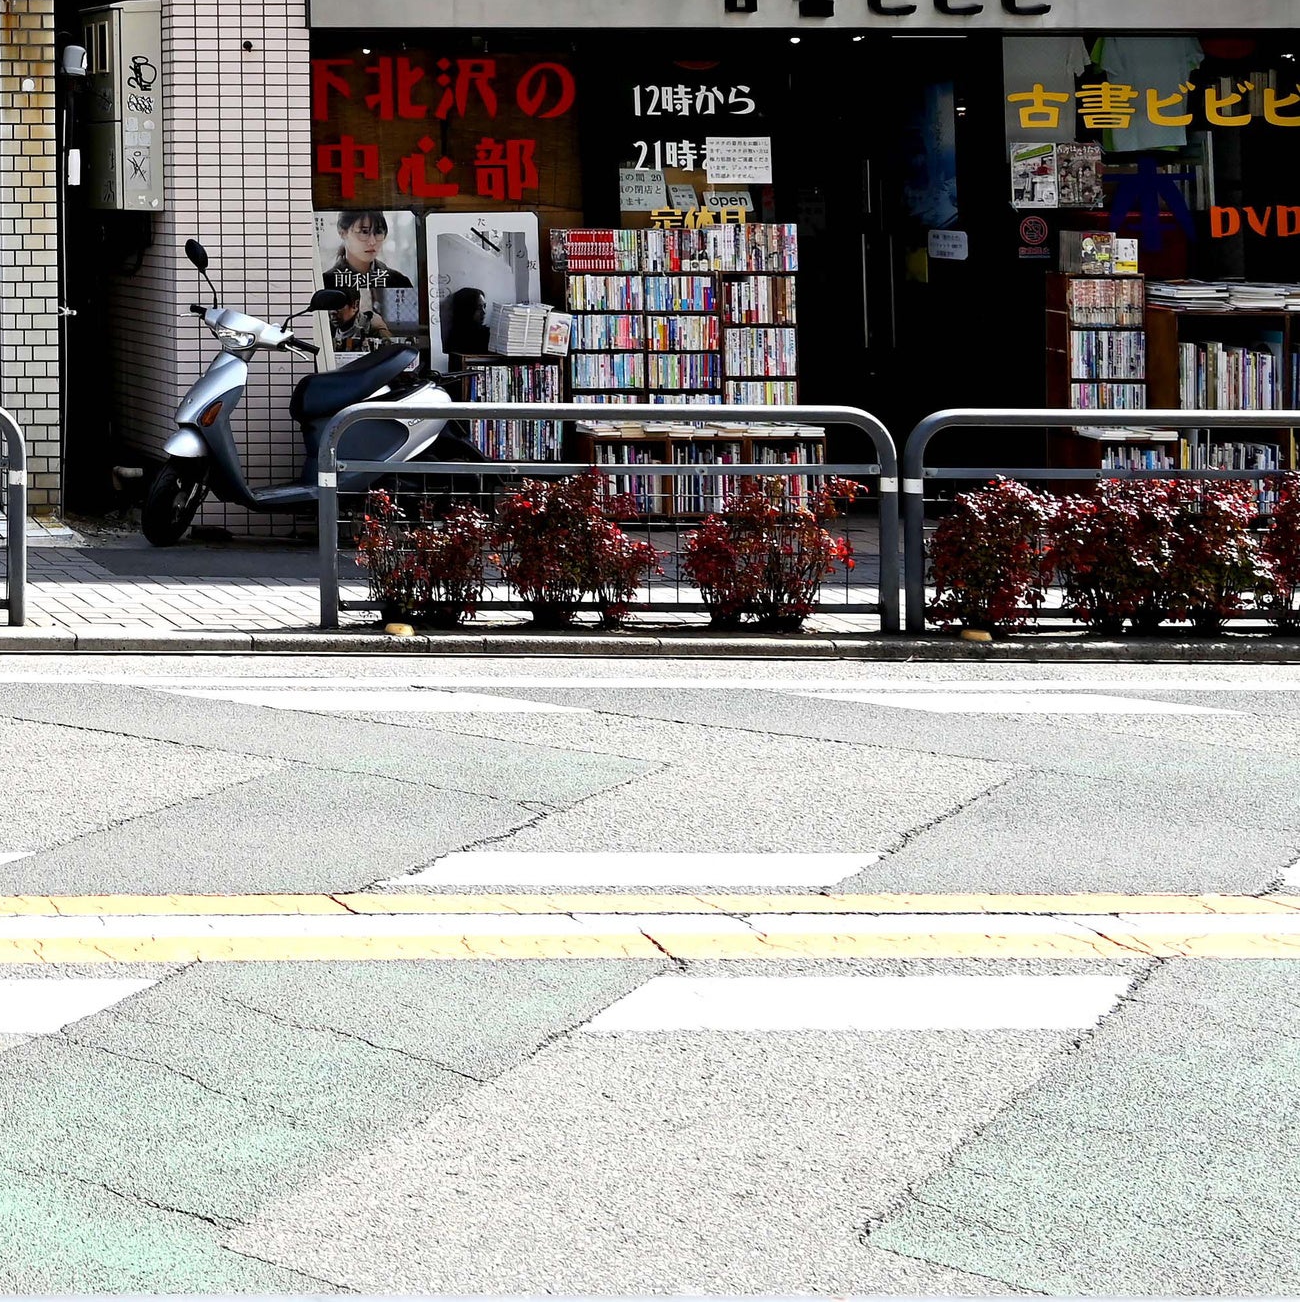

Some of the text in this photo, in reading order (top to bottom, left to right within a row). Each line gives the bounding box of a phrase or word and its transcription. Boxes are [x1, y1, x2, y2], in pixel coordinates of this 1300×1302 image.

[311, 57, 575, 120] 下北沢の
[633, 84, 756, 117] 12時から
[1007, 81, 1300, 129] 古書ビビビ
[317, 135, 539, 200] 中心部
[650, 173, 662, 182] 20
[709, 195, 748, 208] open
[1210, 205, 1300, 238] DVD
[333, 268, 390, 291] 前科者
